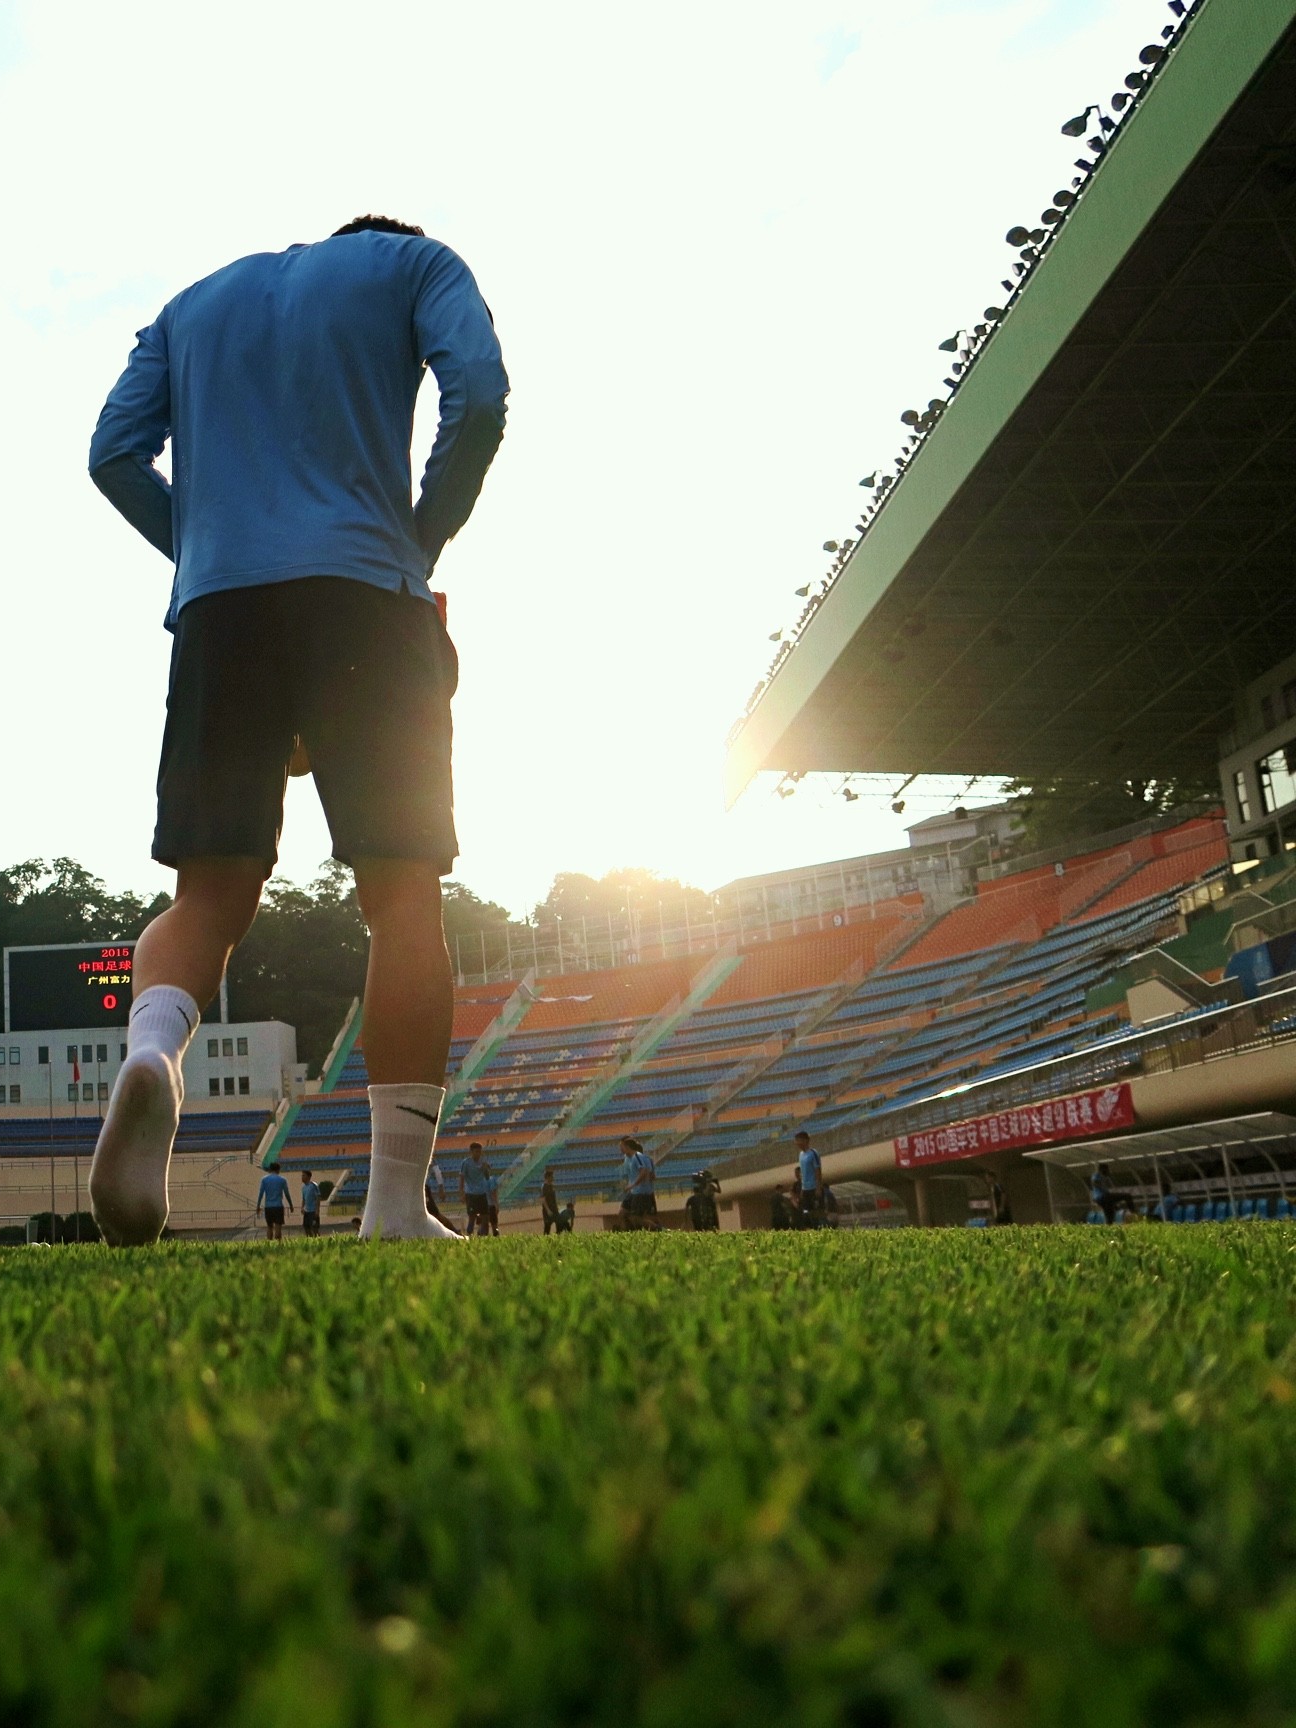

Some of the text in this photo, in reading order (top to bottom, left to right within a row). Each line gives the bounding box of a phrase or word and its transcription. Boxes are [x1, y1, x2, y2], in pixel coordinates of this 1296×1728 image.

[833, 914, 842, 926] 9
[101, 947, 130, 958] 2015
[78, 960, 132, 973] 中国足球
[87, 974, 131, 986] 广州富力
[102, 993, 118, 1010] 0
[914, 1135, 936, 1158] 2015
